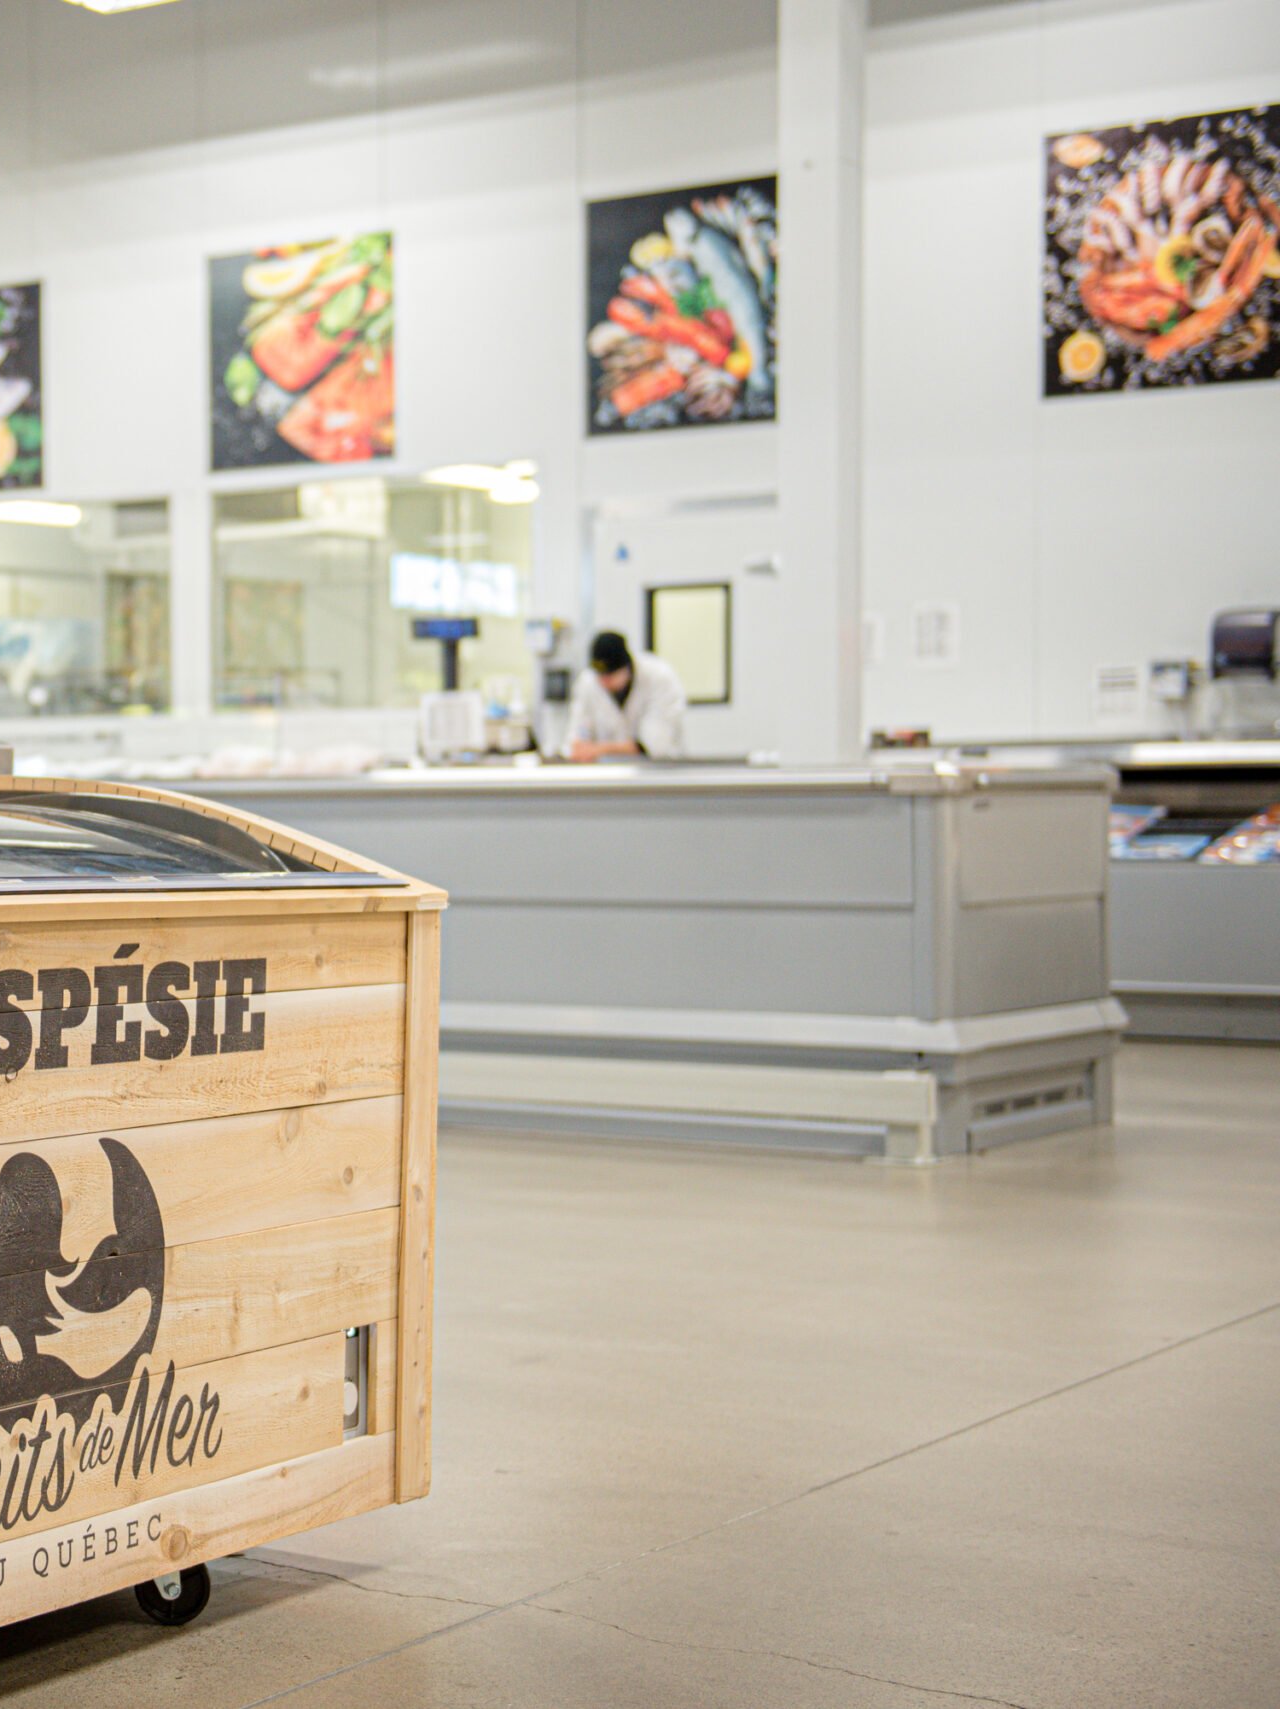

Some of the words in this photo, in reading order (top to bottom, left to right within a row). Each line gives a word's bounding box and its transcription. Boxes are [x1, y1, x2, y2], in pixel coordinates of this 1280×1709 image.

[78, 1407, 116, 1474] de
[113, 1358, 224, 1488] Mer
[31, 1513, 163, 1578] QUÉBEC
